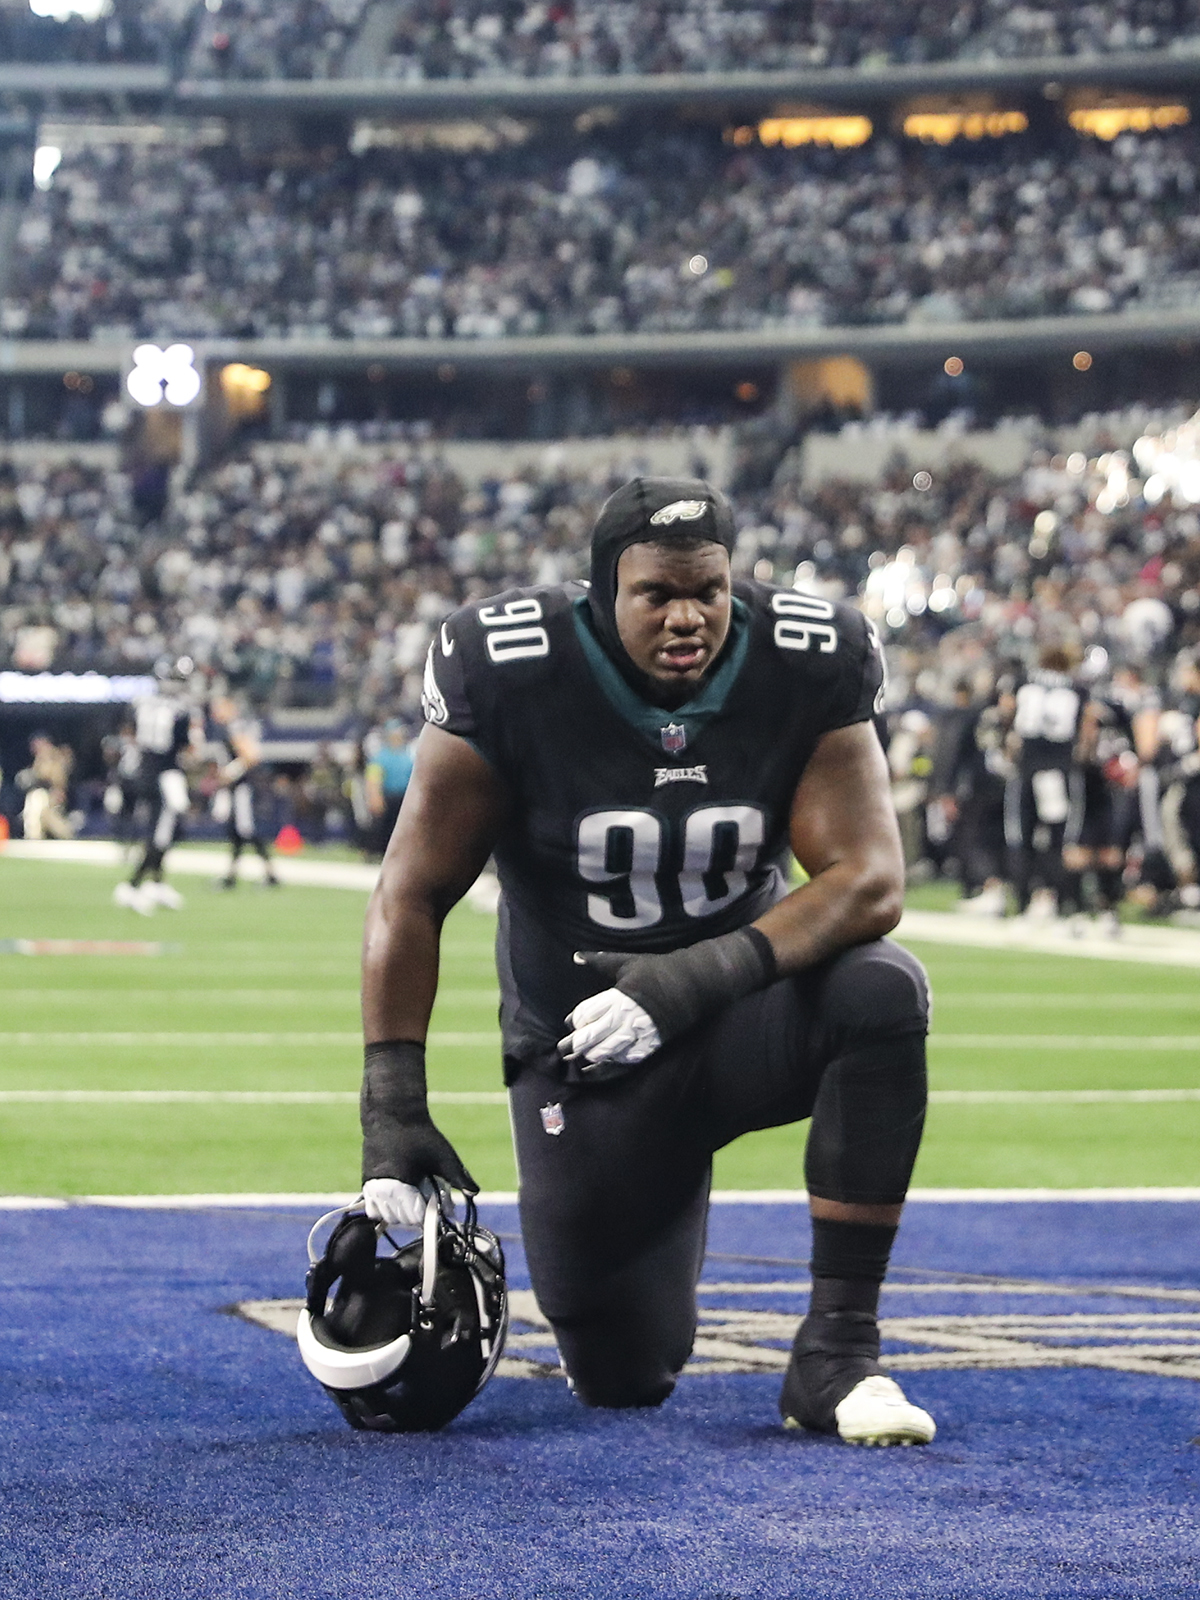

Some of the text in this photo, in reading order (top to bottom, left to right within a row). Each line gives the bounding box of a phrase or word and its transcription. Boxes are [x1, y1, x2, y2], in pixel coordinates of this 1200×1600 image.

[478, 599, 549, 663] 90
[772, 593, 837, 654] 90
[653, 764, 709, 788] EAGLES
[578, 806, 764, 929] 90
